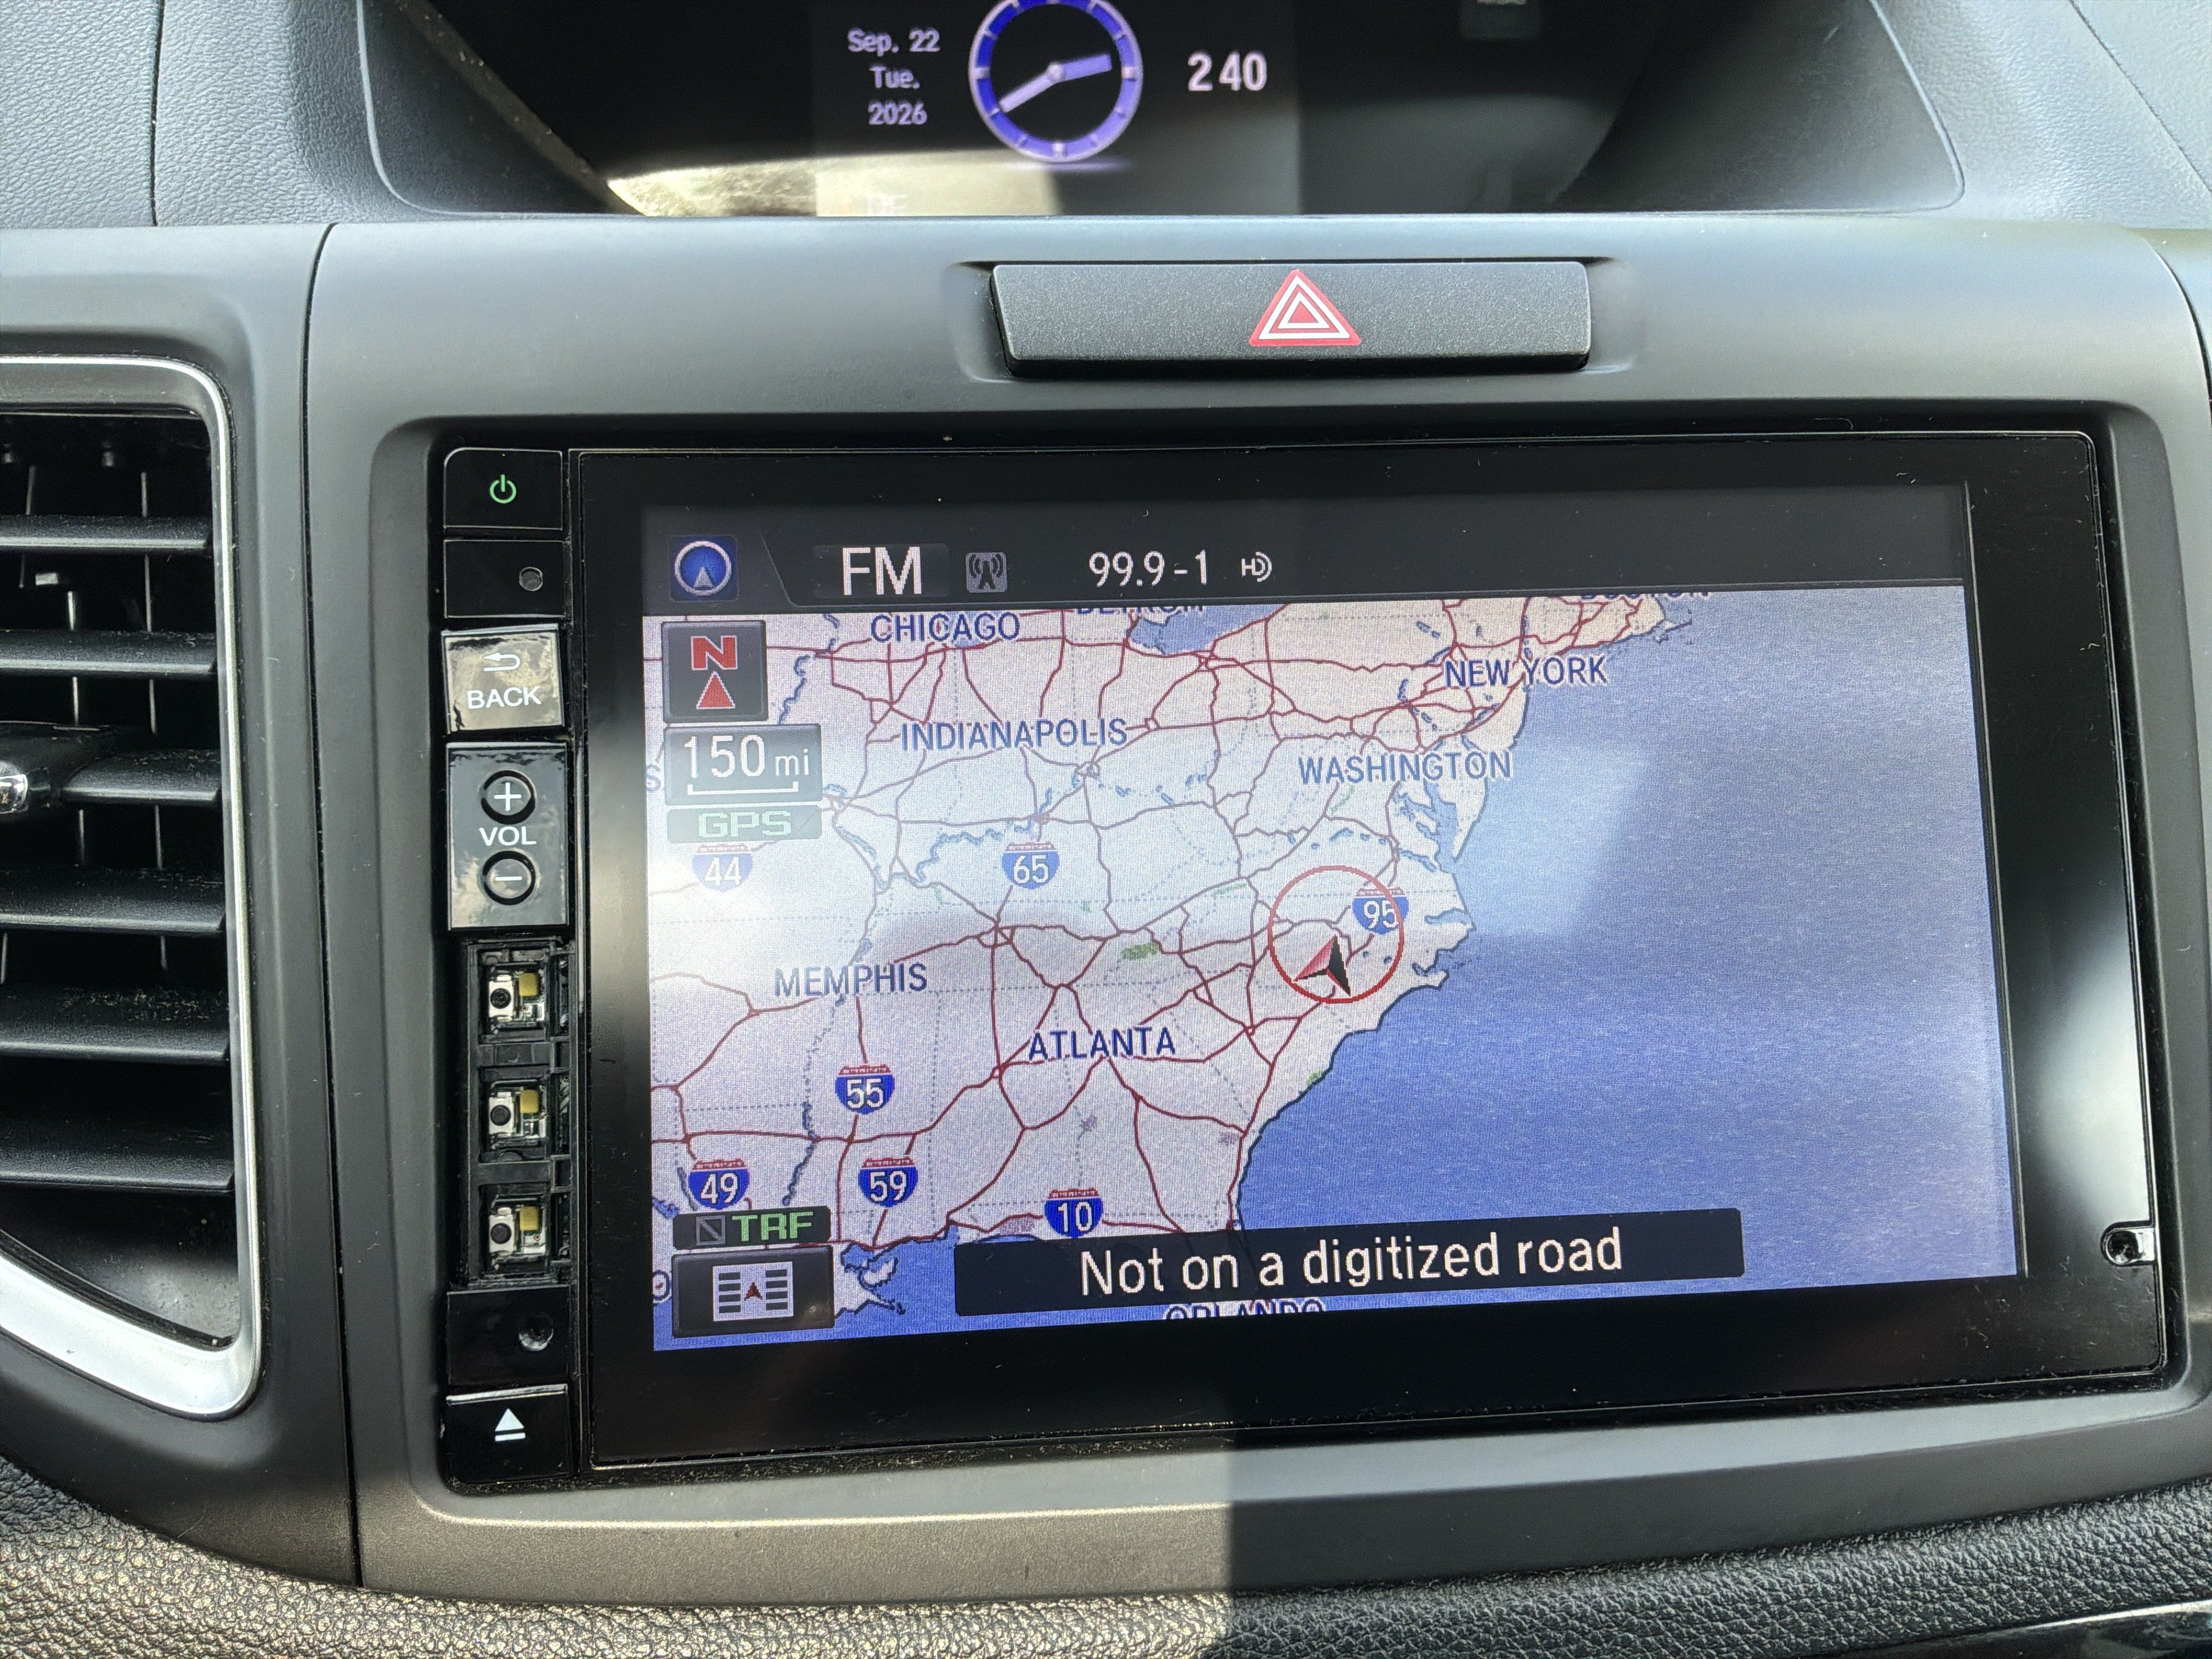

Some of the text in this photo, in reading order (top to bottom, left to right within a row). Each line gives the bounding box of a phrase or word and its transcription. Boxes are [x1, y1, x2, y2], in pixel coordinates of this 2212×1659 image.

[848, 29, 940, 56] Sep. 22
[870, 66, 919, 89] Tue.
[868, 102, 927, 125] 2026
[842, 546, 922, 596] FM
[871, 612, 1020, 643] CHICAGO
[1445, 656, 1607, 687] NEW YORK
[467, 686, 541, 709] BACK
[902, 718, 1127, 751] INDIANAPOLIS
[684, 735, 809, 778] 150 mi
[1299, 752, 1511, 784] WASHINGTON
[479, 826, 537, 846] VOL
[698, 811, 792, 838] GPS
[704, 856, 741, 886] 44
[1013, 855, 1048, 884] 65
[1363, 900, 1398, 930] 95
[774, 963, 928, 997] MEMPHIS
[1029, 1027, 1176, 1060] ATLANTA
[847, 1078, 884, 1108] 55
[700, 1172, 739, 1204] 49
[870, 1170, 907, 1201] 59
[731, 1211, 814, 1242] TRF
[1057, 1201, 1093, 1233] 10
[1080, 1226, 1622, 1295] Not on a digitized road
